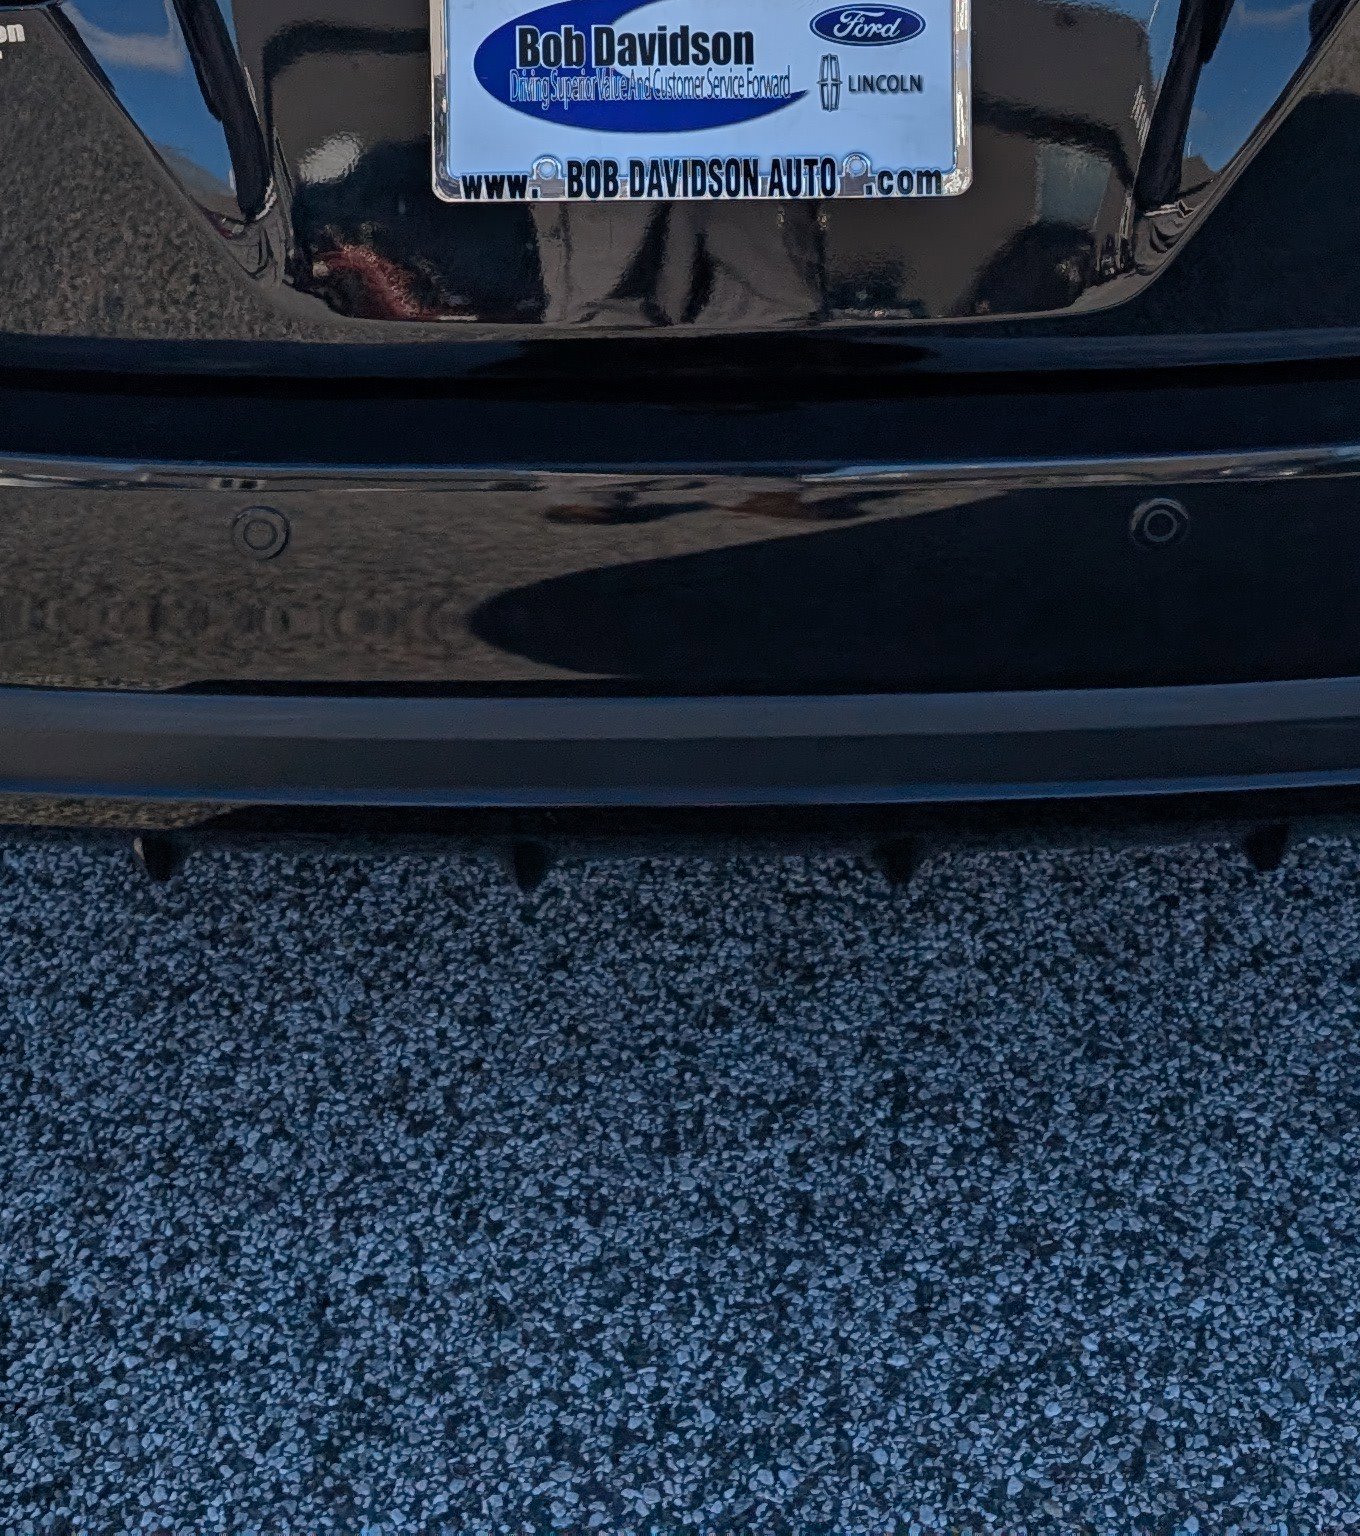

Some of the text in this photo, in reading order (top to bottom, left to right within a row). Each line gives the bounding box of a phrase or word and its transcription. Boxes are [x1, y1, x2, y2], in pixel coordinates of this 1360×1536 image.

[833, 10, 903, 37] Ford
[516, 24, 755, 68] Bob Davidson
[510, 65, 791, 110] Driving Superior Value And Customer Service Forward
[848, 74, 924, 93] LINCOLN
[461, 157, 942, 200] www. BOB DAVIDSON AUTO .com
